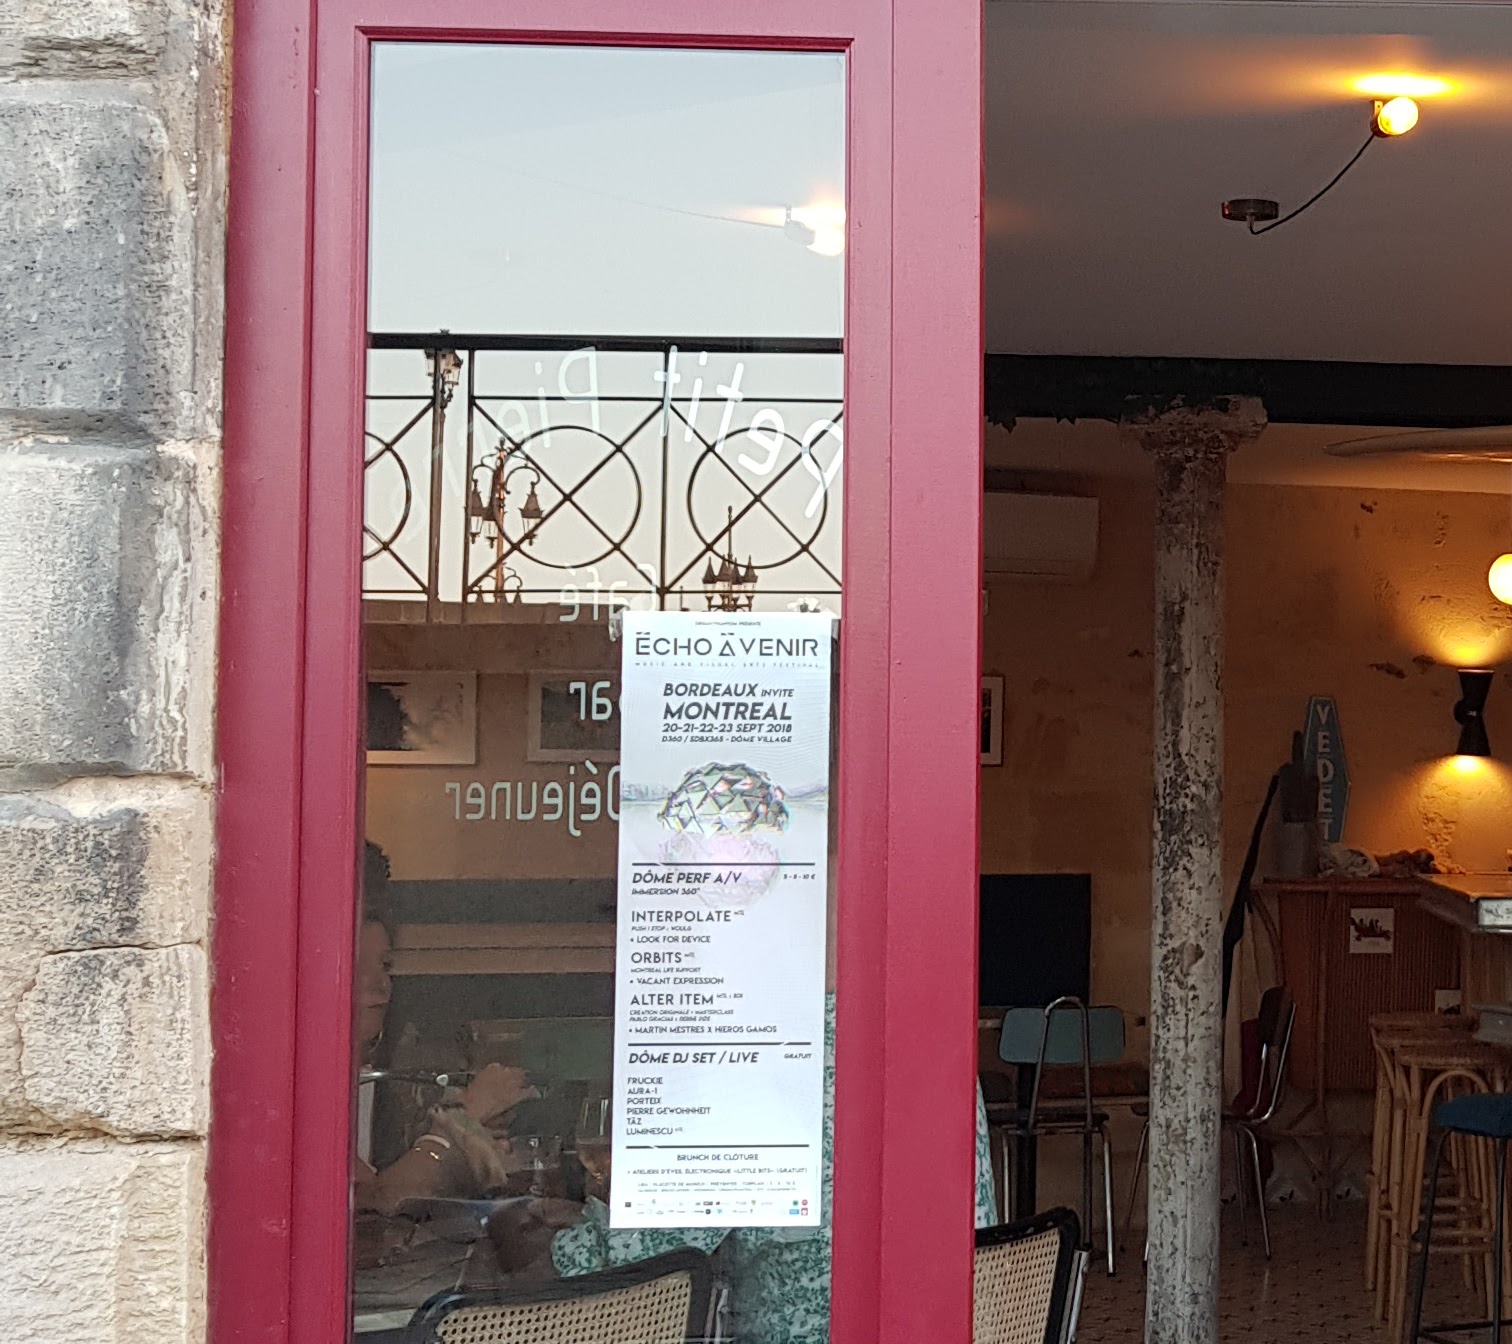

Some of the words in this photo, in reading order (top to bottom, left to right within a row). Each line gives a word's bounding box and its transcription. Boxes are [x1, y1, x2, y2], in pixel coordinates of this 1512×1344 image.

[663, 682, 759, 697] BORDEAUX
[761, 688, 795, 698] INVITE
[663, 701, 793, 721] MONTREAL
[661, 723, 734, 733] 20-21-22-23
[736, 723, 764, 733] SEPT
[765, 723, 793, 733] 2018
[1315, 704, 1335, 842] VEDET
[632, 869, 674, 884] DÔME
[676, 872, 712, 884] PERF
[713, 870, 743, 886] A/V
[631, 910, 731, 923] INTERPOLATE
[682, 935, 711, 943] DEVICE
[630, 951, 682, 964] ORBITS
[636, 977, 671, 985] VACANT
[673, 977, 724, 985] EXPRESSION
[630, 993, 674, 1006] ALTER
[679, 993, 714, 1006] ITEM
[635, 1025, 668, 1034] MARTIN
[669, 1025, 705, 1034] MESTRES
[628, 1050, 669, 1064] DÔME
[672, 1052, 689, 1064] DJ
[691, 1052, 716, 1064] SET
[728, 1052, 760, 1063] LIVE
